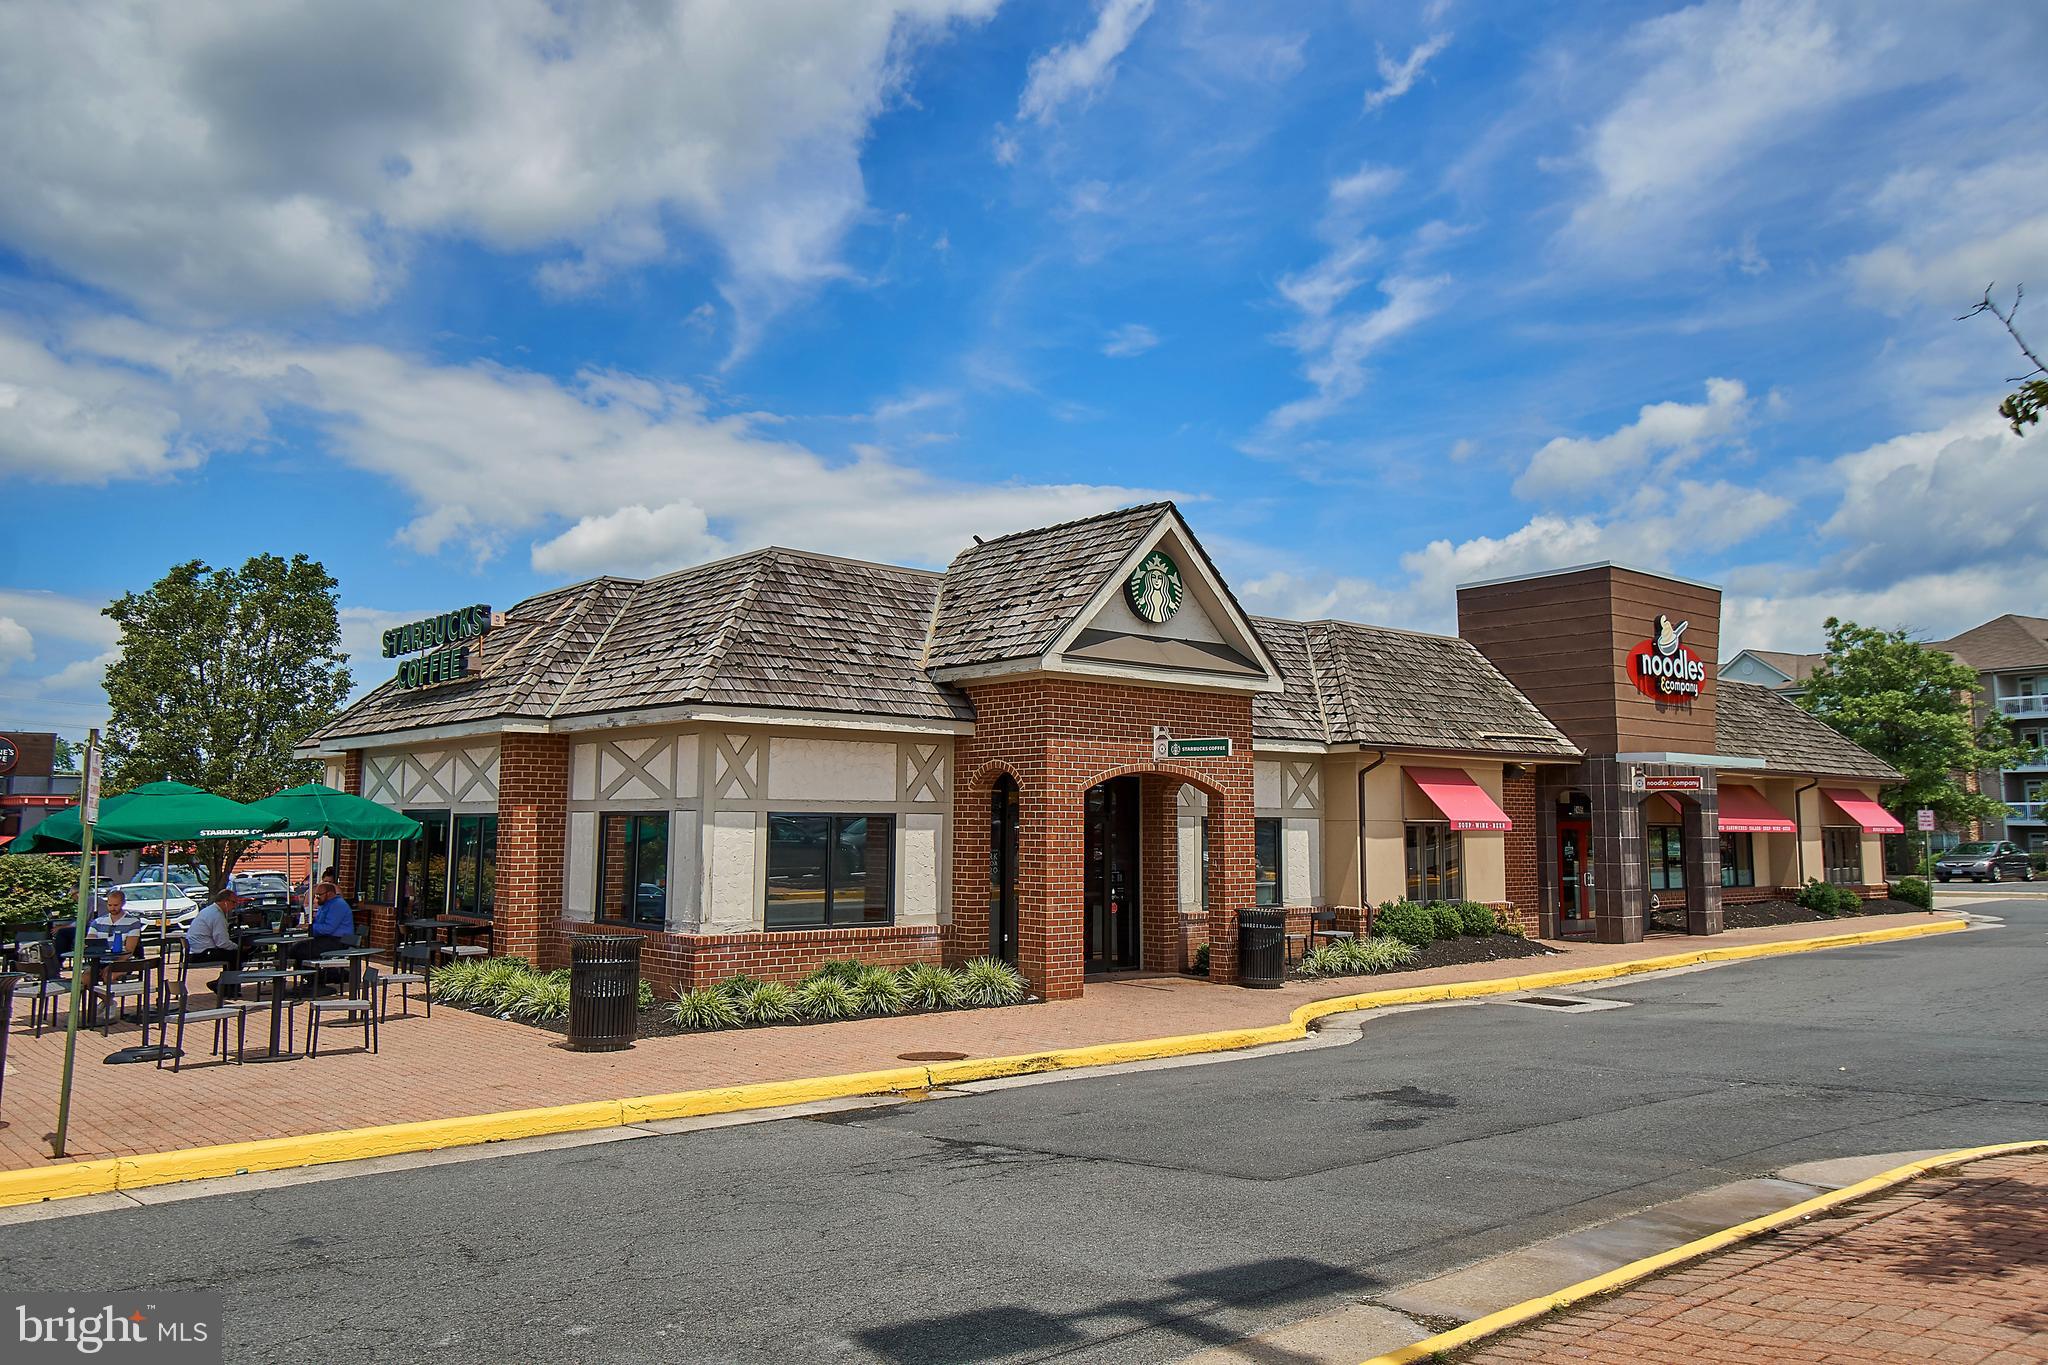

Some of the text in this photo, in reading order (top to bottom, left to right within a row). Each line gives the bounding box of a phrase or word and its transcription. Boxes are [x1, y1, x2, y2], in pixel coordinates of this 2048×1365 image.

[382, 604, 491, 658] STARBUCKS
[397, 646, 468, 689] COFFEE
[1641, 649, 1705, 682] noodles
[199, 829, 250, 837] STARBUCKS
